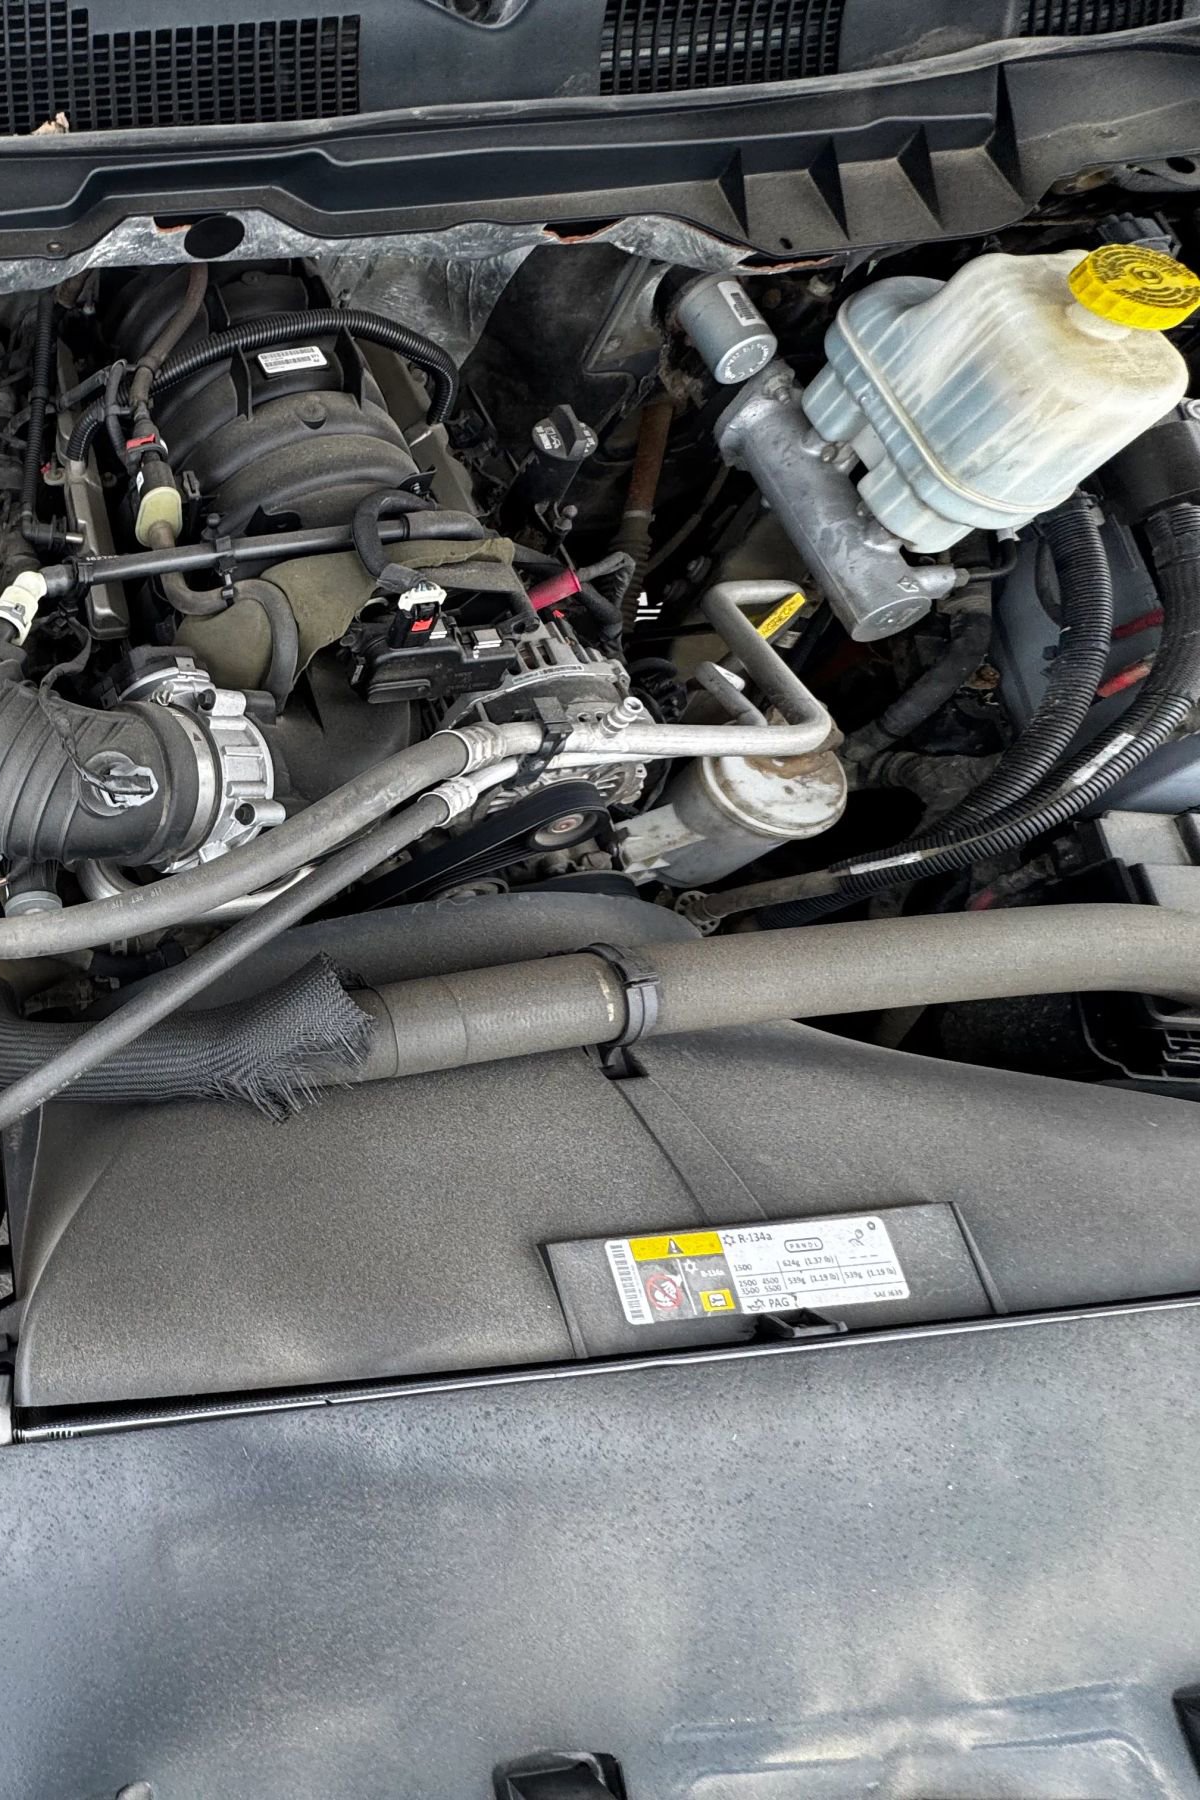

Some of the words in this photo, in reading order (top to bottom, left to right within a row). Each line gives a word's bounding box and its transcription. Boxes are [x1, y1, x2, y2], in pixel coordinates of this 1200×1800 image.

[738, 1232, 773, 1244] R-134a
[734, 1263, 753, 1272] 1500
[768, 1297, 791, 1308] PAG
